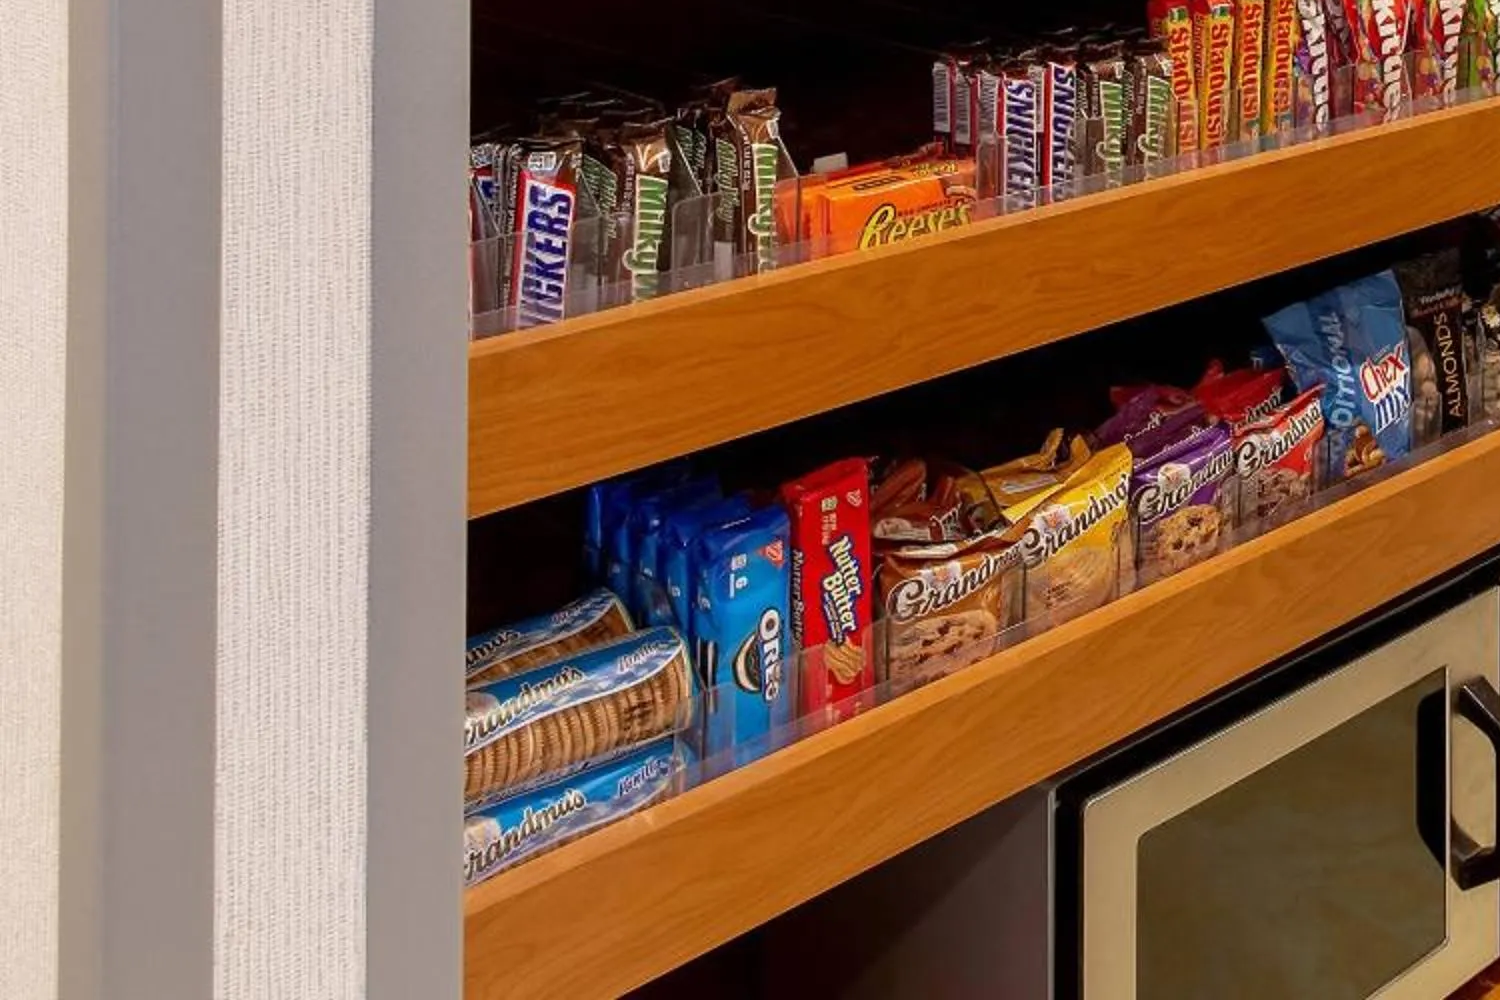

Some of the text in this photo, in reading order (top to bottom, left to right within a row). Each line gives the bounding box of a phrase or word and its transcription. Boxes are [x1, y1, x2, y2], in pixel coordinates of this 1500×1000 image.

[623, 175, 669, 274] Milky
[859, 203, 973, 251] Reese's
[1319, 312, 1357, 428] DITIONAL
[1360, 341, 1409, 402] Chex
[1434, 312, 1464, 417] ALMONDS
[822, 574, 857, 632] Butter
[828, 535, 862, 595] Nutter
[759, 608, 782, 701] OREO
